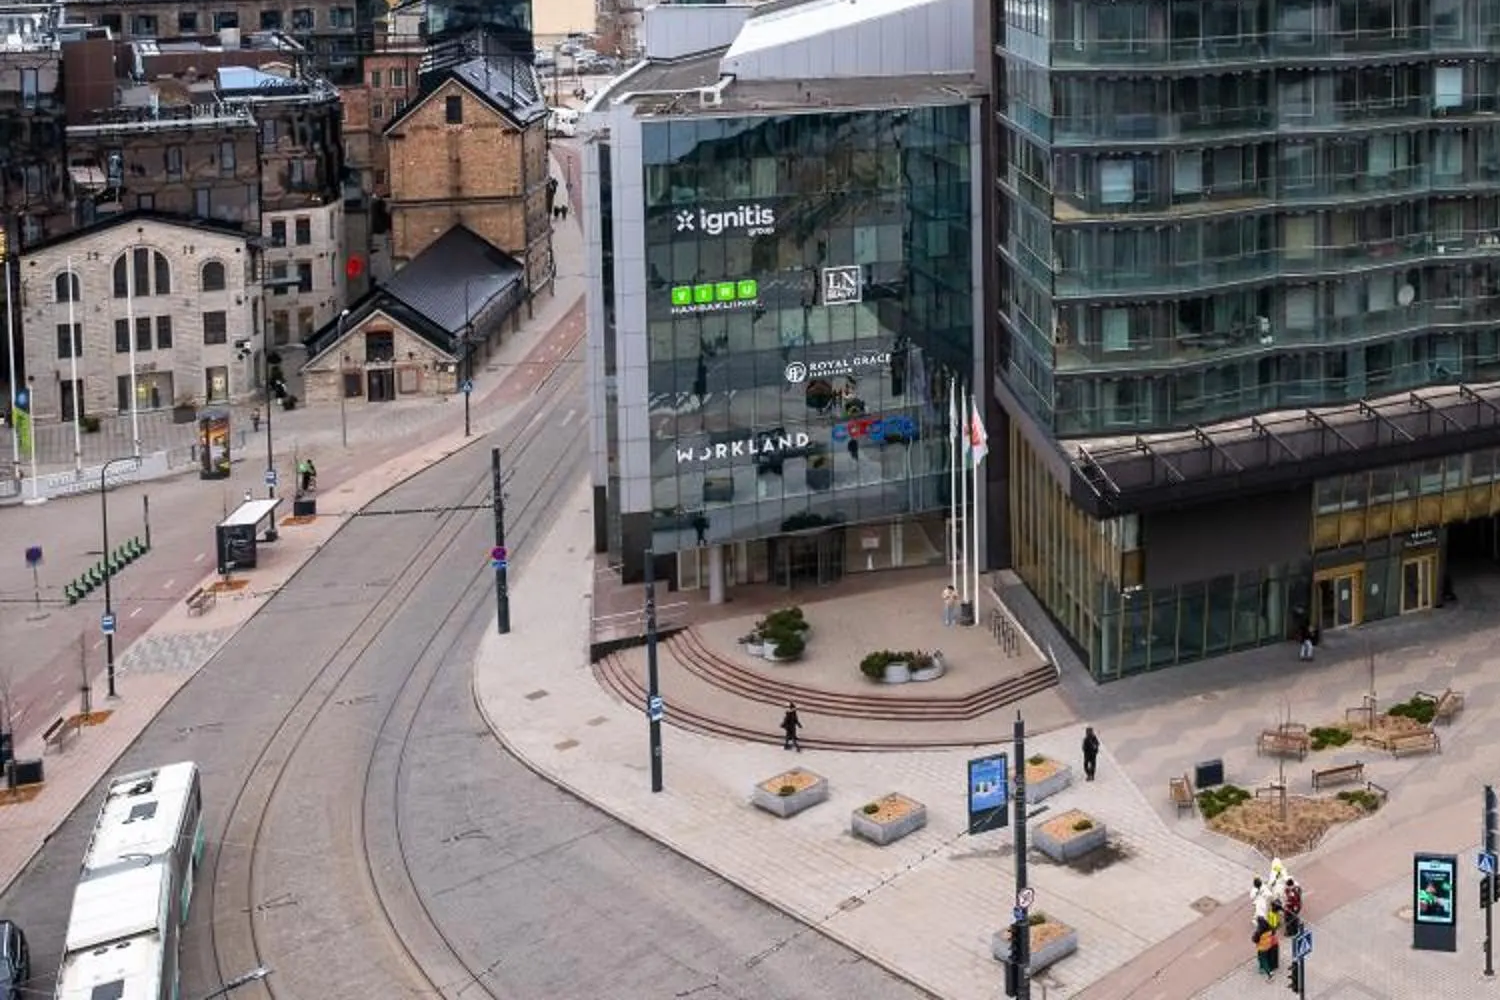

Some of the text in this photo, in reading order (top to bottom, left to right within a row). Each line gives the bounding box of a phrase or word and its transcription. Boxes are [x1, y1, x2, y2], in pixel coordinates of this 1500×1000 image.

[700, 204, 775, 235] ignitis
[809, 353, 892, 371] ROYAL GRACE
